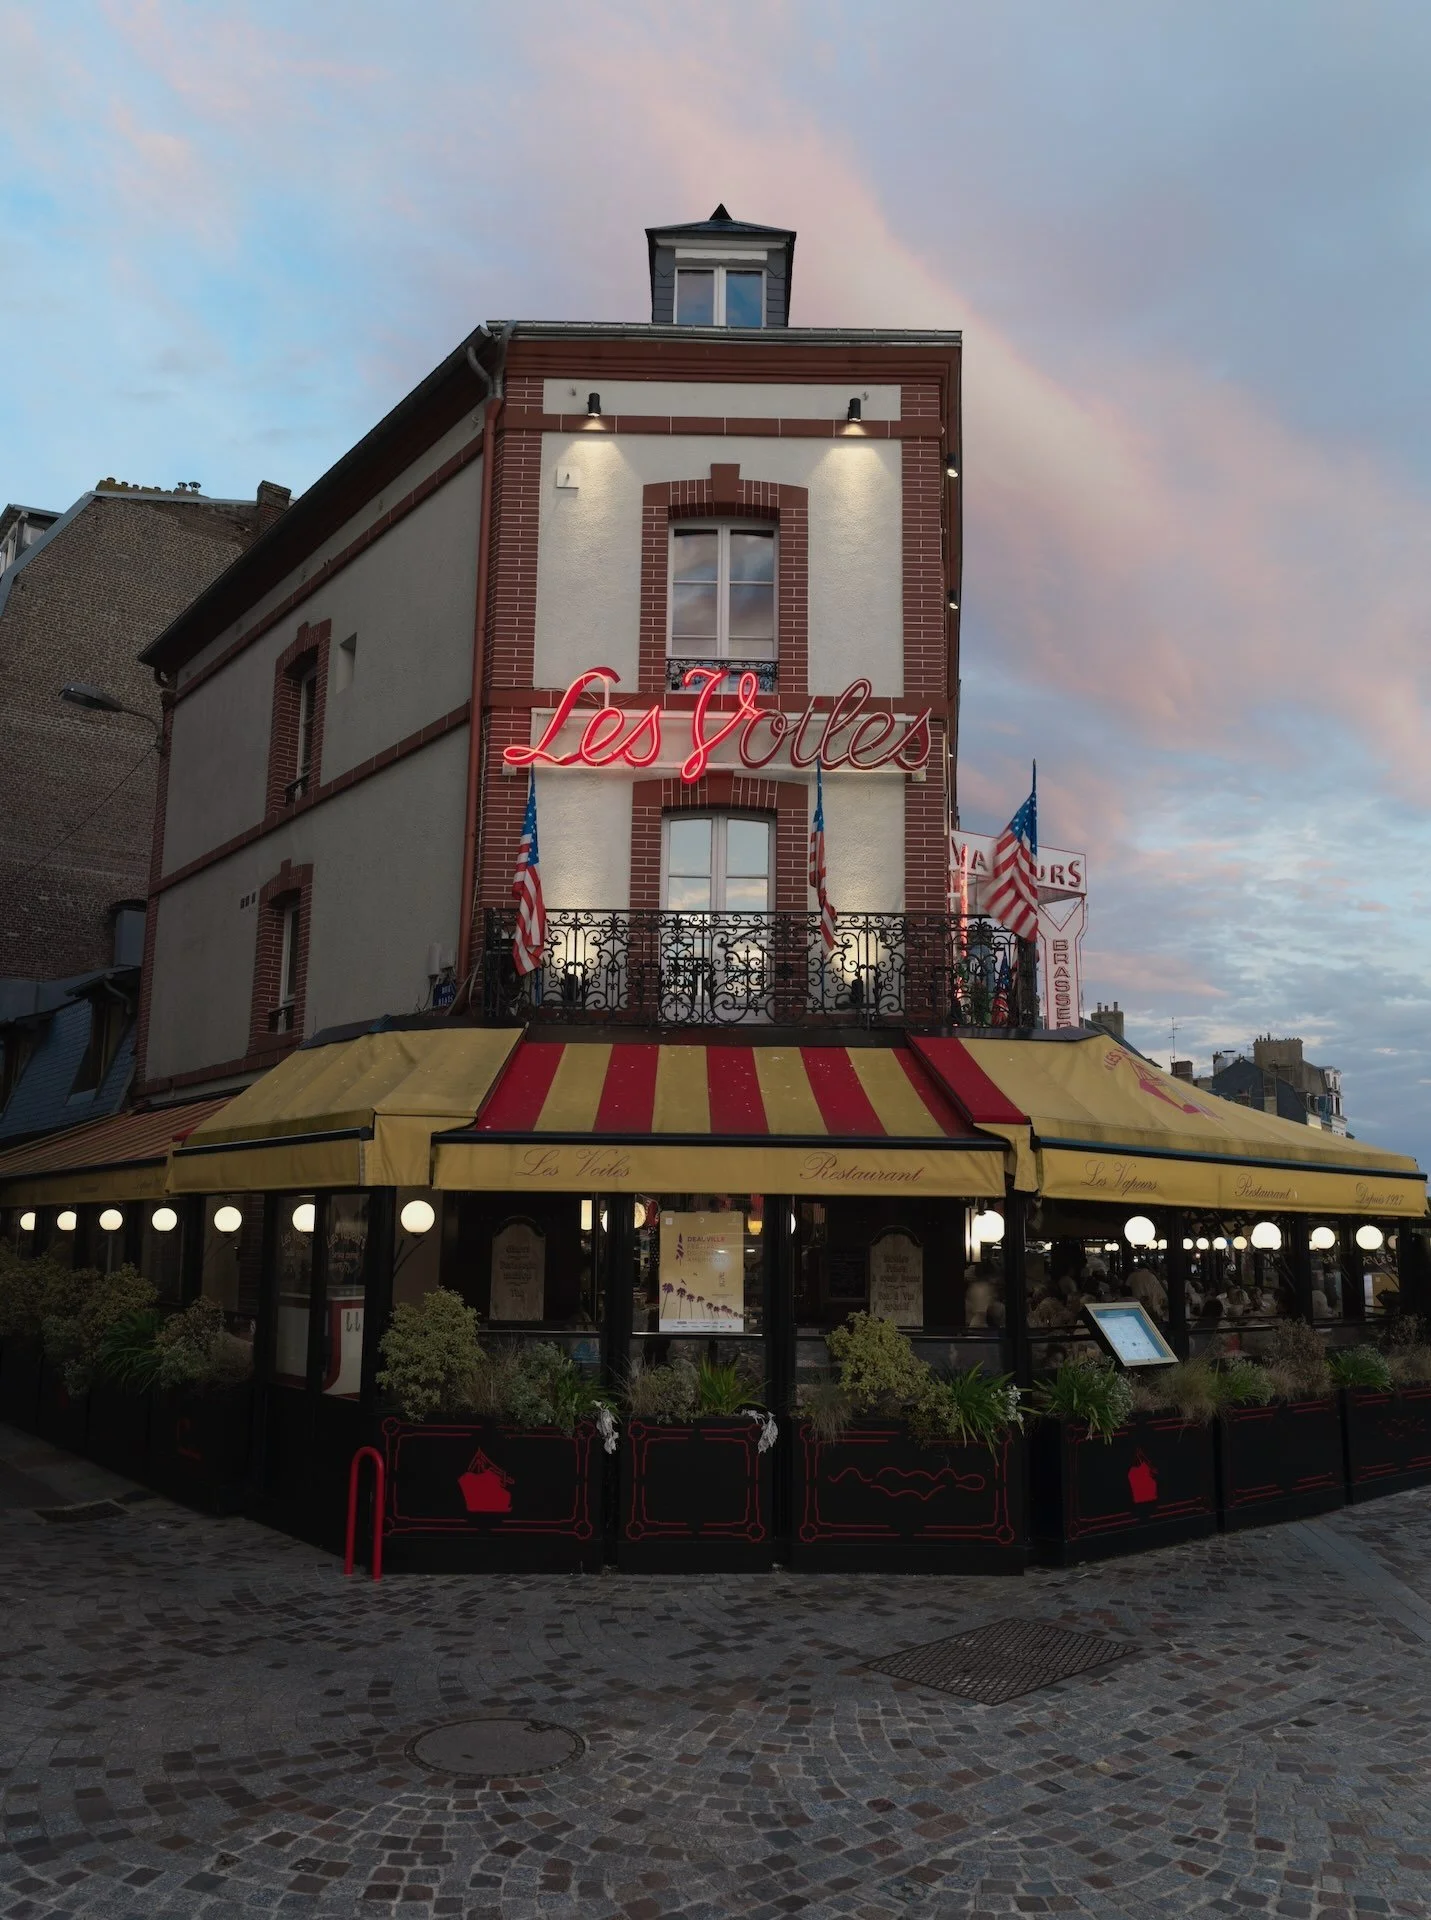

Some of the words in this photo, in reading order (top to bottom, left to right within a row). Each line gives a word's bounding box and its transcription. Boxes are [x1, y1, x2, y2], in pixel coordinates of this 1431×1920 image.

[503, 666, 661, 767] Les
[681, 668, 933, 784] Voiles
[950, 836, 1082, 888] VAURS
[515, 1147, 560, 1176] Les
[576, 1149, 631, 1177] Voiles
[799, 1151, 926, 1182] Restaurant
[1081, 1160, 1107, 1187] Les
[1111, 1162, 1157, 1196] Vapeurs
[1235, 1173, 1291, 1200] Restaurant
[1355, 1182, 1384, 1210] Depuis
